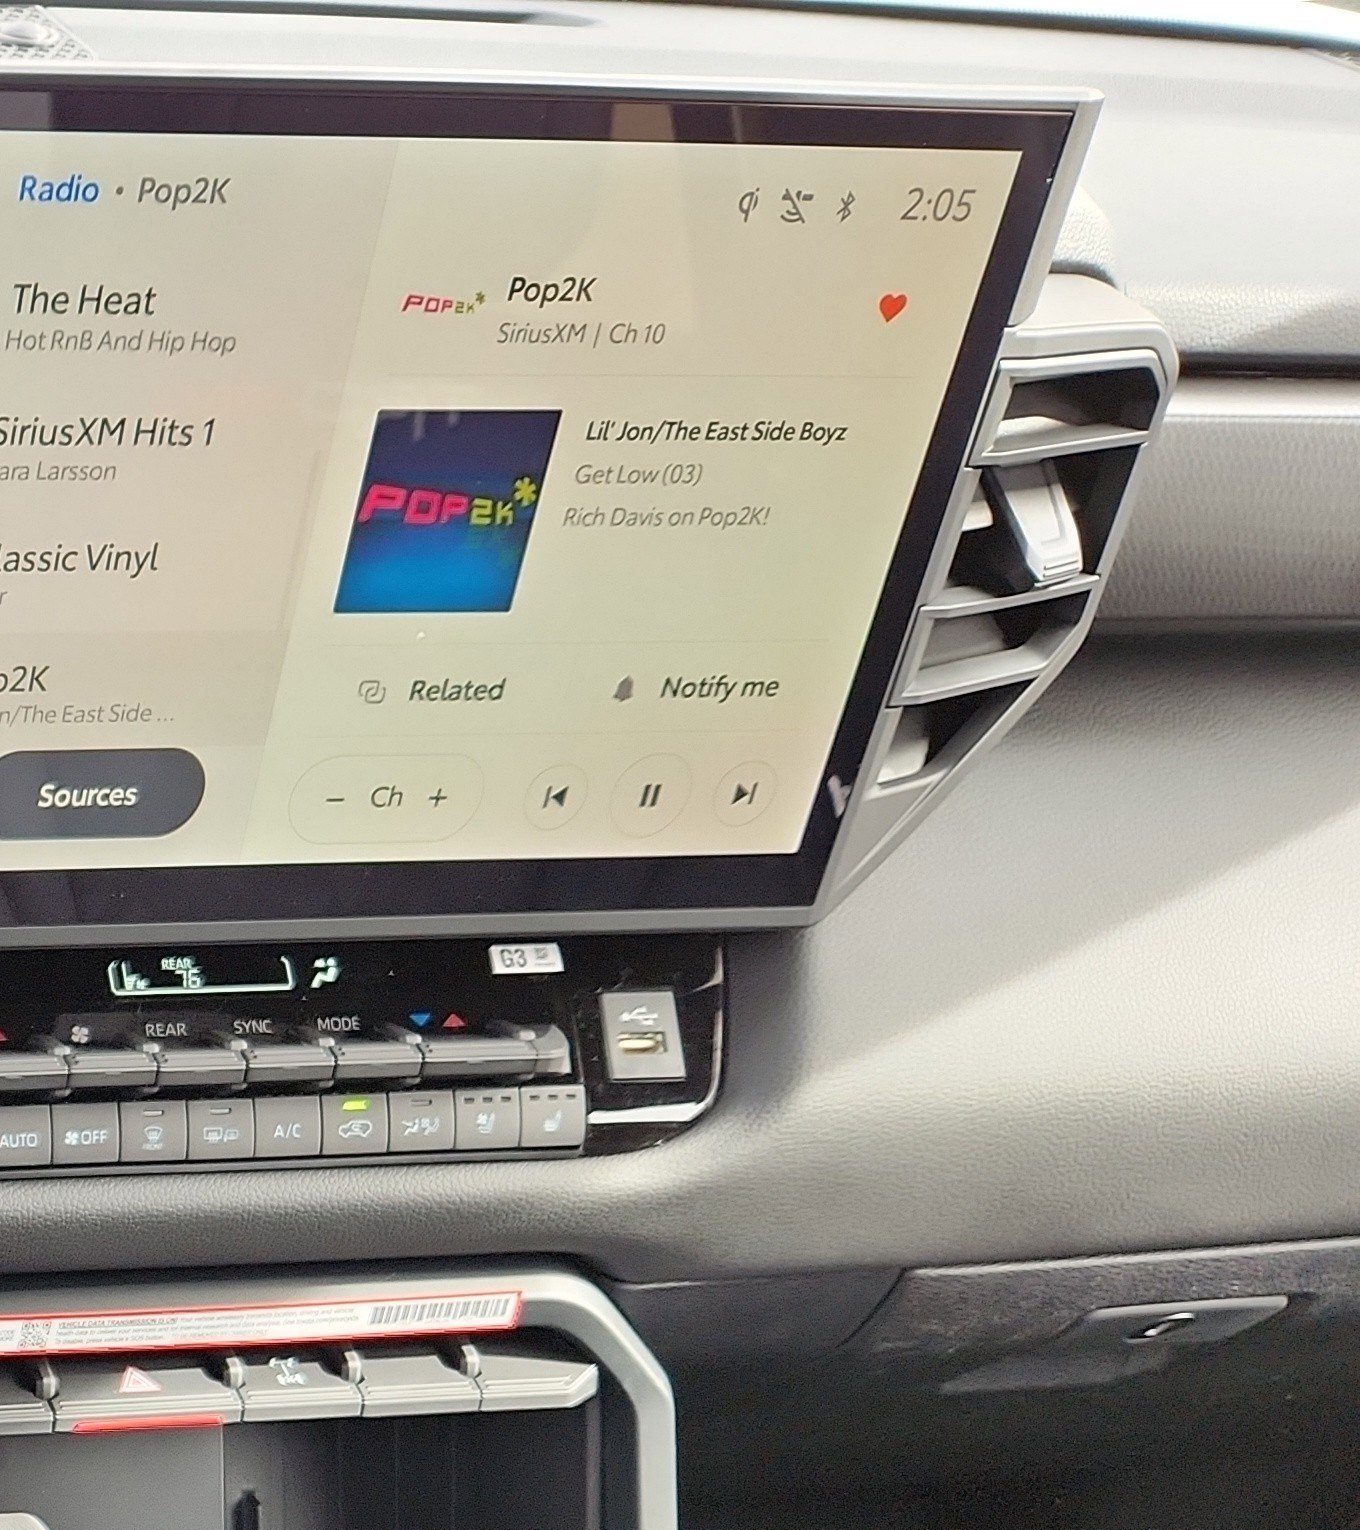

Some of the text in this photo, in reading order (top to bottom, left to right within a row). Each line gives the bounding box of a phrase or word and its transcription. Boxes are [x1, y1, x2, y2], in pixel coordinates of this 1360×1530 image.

[18, 174, 232, 210] Radio Pop2K
[901, 186, 978, 223] 2:05
[12, 284, 157, 317] The Heat
[507, 276, 598, 307] Pop2K
[4, 329, 237, 355] Hot RnB And Hip Hop
[496, 322, 667, 346] SiriusXM Ch 10
[131, 415, 196, 448] Hits
[200, 415, 216, 447] 1
[584, 419, 848, 446] Lil' Jon/The East Side Boyz
[35, 460, 118, 483] Larsson
[574, 463, 704, 488] Get Low (03)
[562, 506, 772, 533] Rich Davis on Pop2K!
[85, 541, 160, 581] Vinyl
[409, 678, 506, 702] Related
[659, 675, 780, 704] Notify me
[61, 704, 106, 725] East
[108, 703, 153, 725] Side
[37, 781, 139, 809] Sources
[369, 785, 404, 808] Ch
[161, 956, 193, 971] REAR
[144, 1022, 188, 1038] REAR
[232, 1018, 274, 1035] SYNC
[316, 1016, 361, 1032] MODE
[80, 1128, 109, 1147] OFF
[273, 1121, 303, 1140] A/C
